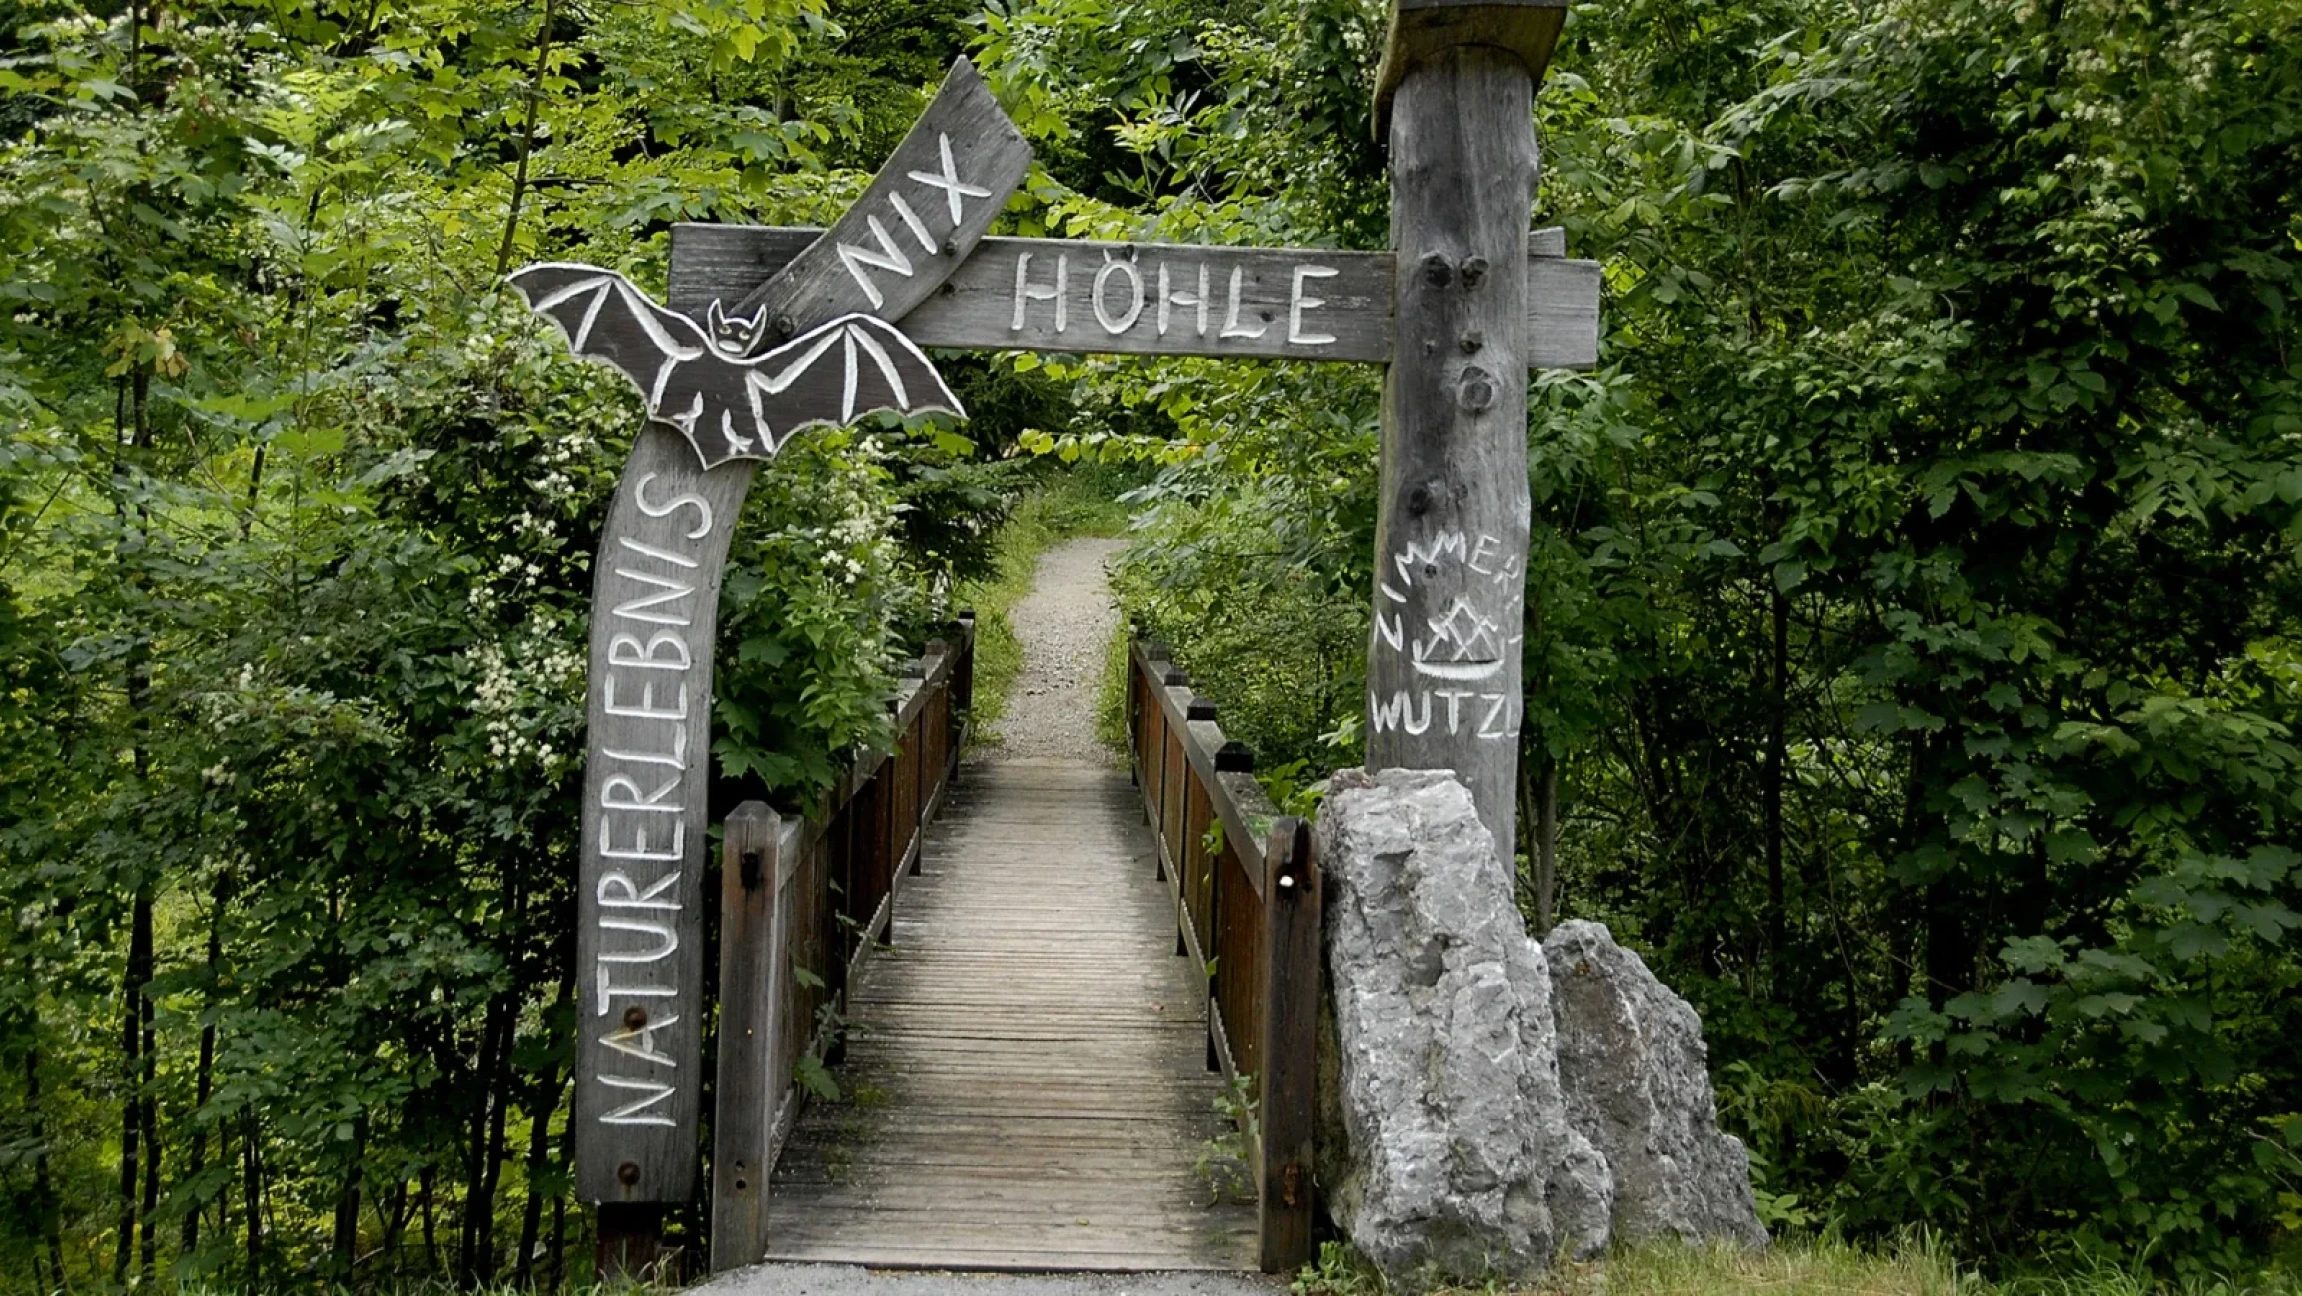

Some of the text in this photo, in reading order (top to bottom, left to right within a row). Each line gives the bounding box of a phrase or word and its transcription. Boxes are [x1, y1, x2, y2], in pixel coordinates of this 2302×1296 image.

[837, 132, 991, 310] NIX
[1010, 246, 1339, 345] HÖHLE
[597, 470, 712, 1127] NATURERLEBNIS
